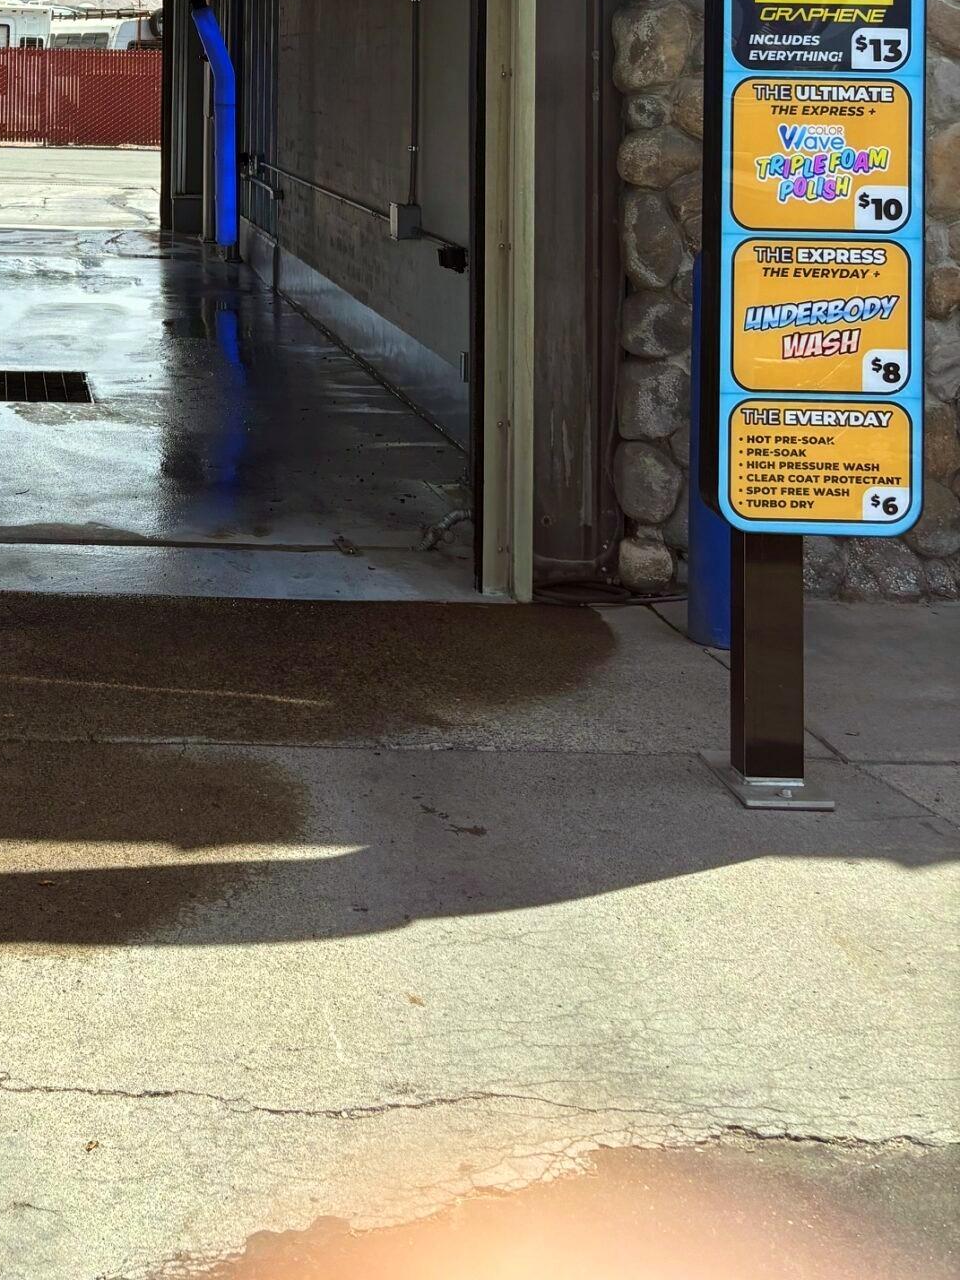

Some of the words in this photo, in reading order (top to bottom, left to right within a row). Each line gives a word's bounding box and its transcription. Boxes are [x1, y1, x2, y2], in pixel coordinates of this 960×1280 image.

[759, 7, 887, 23] GRAPHENE
[748, 34, 820, 46] INCLUDES
[855, 34, 903, 63] $13
[748, 50, 843, 62] EVERYTHING!
[753, 84, 792, 101] THE
[795, 85, 894, 102] ULTIMATE
[771, 105, 798, 115] THE
[802, 106, 865, 116] EXPRESS
[808, 126, 843, 135] COLOR
[756, 154, 827, 179] TRIPLE
[829, 148, 889, 174] FOAM
[779, 176, 850, 201] POLISH
[858, 192, 903, 221] $10
[754, 246, 793, 263] THE
[797, 247, 887, 265] EXPRESS
[762, 267, 788, 277] THE
[793, 268, 869, 279] EVERYDAY
[744, 295, 900, 332] UNDERBODY
[782, 328, 861, 360] WASH
[871, 357, 901, 383] $8
[742, 408, 780, 425] THE
[783, 409, 893, 428] EVERYDAY
[746, 435, 770, 444] HOT
[774, 436, 835, 445] PRE-SOAK
[746, 448, 806, 457] PRE-SOAK
[746, 461, 775, 470] HIGH
[779, 461, 839, 471] PRESSURE
[843, 462, 880, 472] WASH
[746, 473, 784, 483] CLEAR
[788, 474, 819, 484] COAT
[823, 475, 902, 485] PROTECTANT
[746, 486, 777, 495] SPOT
[781, 487, 810, 496] FREE
[813, 487, 850, 497] WASH
[870, 494, 899, 516] $6
[746, 499, 787, 508] TURBO
[790, 500, 815, 509] DRY
